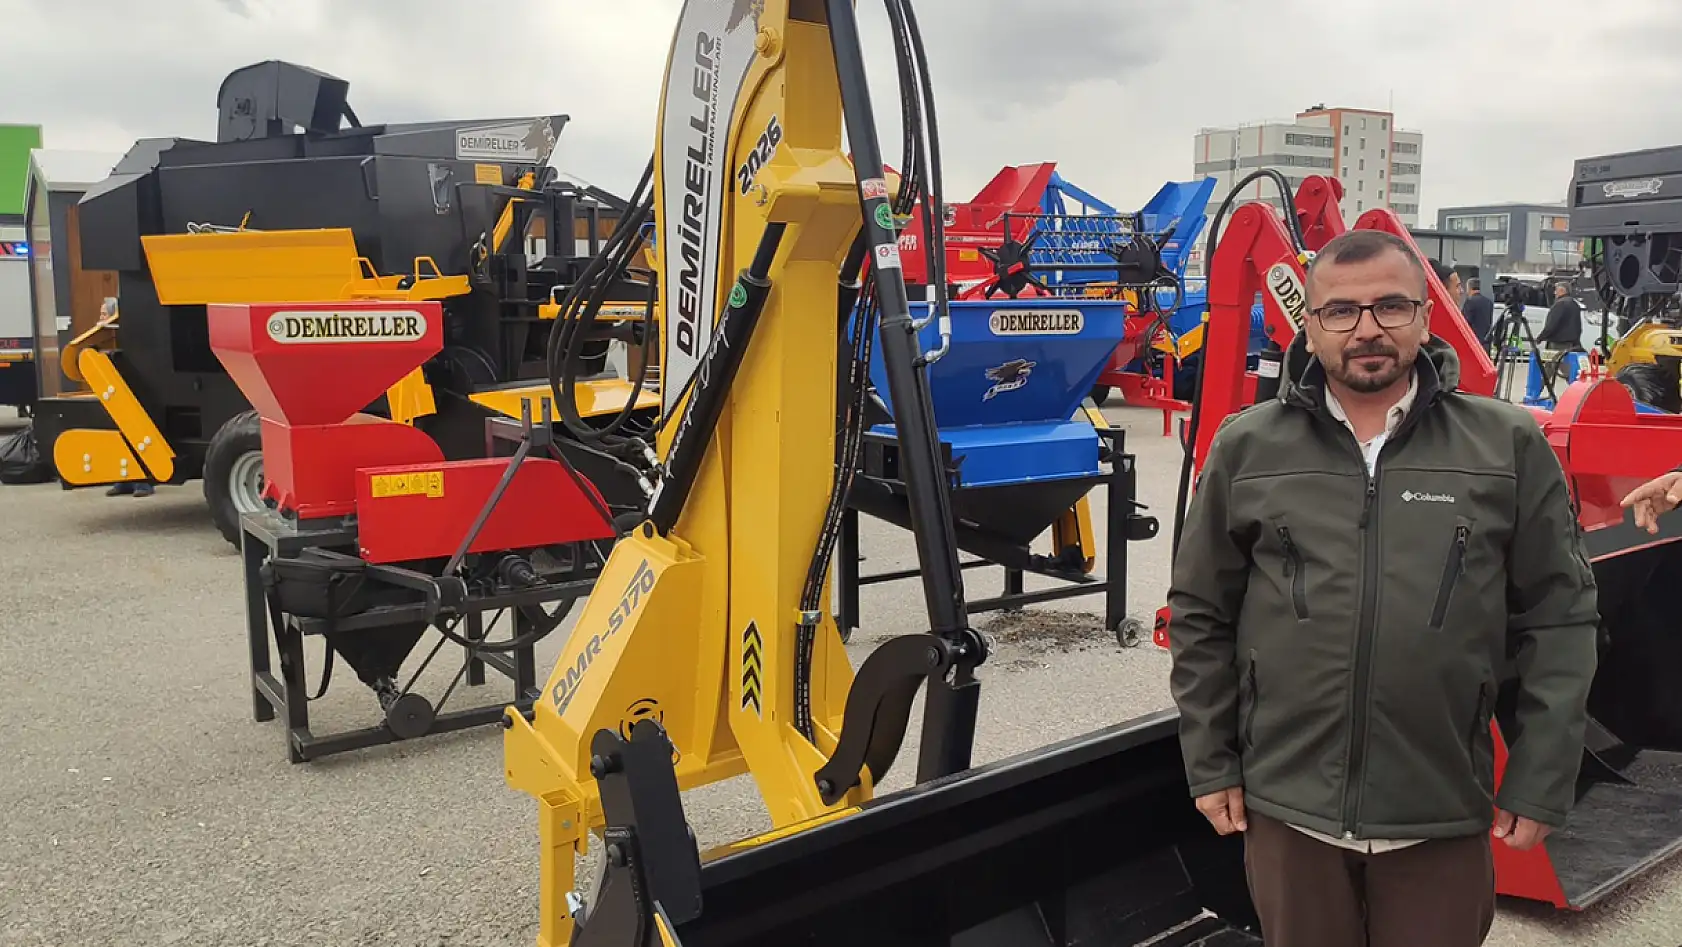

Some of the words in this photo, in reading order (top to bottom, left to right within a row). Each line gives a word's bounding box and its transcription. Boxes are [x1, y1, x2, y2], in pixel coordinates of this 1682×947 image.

[737, 115, 783, 195] 2026
[677, 31, 715, 357] DEMİRELLER
[285, 314, 420, 338] DEMİRELLER
[1000, 312, 1080, 331] DEMİRELLER
[1413, 492, 1455, 503] Columbia
